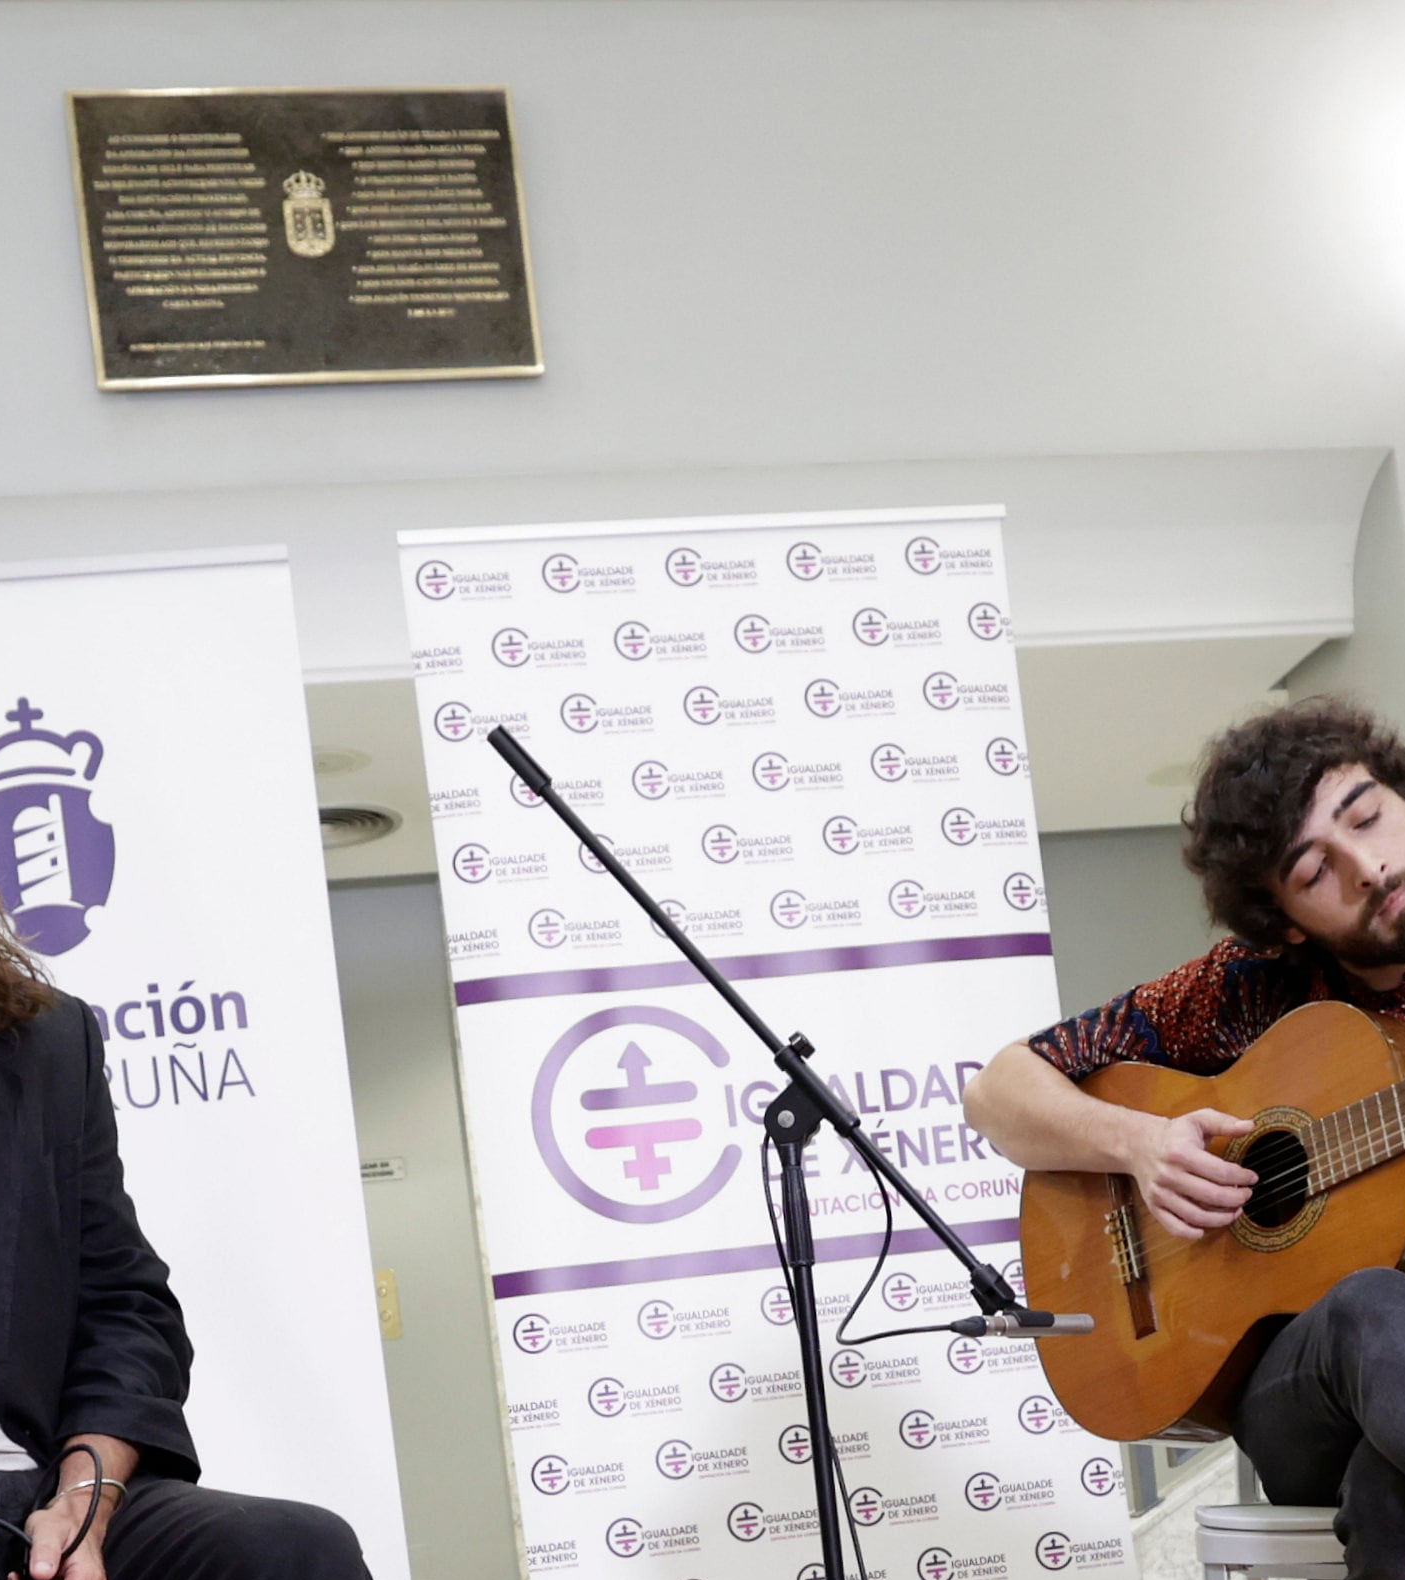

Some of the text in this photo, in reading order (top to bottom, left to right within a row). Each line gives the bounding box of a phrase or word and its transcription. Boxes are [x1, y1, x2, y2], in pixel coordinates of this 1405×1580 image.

[820, 553, 874, 564] IGUALDADE
[938, 548, 991, 558] IGUALDADE
[700, 559, 755, 570] IGUALDADE
[452, 572, 509, 582] IGUALDADE
[577, 566, 633, 576] IGUALDADE
[768, 625, 823, 636] IGUALDADE
[885, 619, 939, 630] IGUALDADE
[527, 638, 584, 649] IGUALDADE
[649, 632, 704, 643] IGUALDADE
[956, 683, 1009, 693] IGUALDADE
[838, 689, 892, 700] IGUALDADE
[718, 697, 773, 708] IGUALDADE
[595, 705, 651, 716] IGUALDADE
[904, 754, 957, 765] IGUALDADE
[786, 762, 841, 773] IGUALDADE
[667, 770, 722, 782] IGUALDADE
[973, 818, 1027, 829] IGUALDADE
[856, 825, 911, 837] IGUALDADE
[736, 835, 791, 846] IGUALDADE
[488, 853, 545, 865] IGUALDADE
[922, 890, 976, 901] IGUALDADE
[804, 899, 859, 911] IGUALDADE
[685, 909, 741, 921] IGUALDADE
[563, 919, 620, 931] IGUALDADE
[836, 1118, 1004, 1176] XÉNER
[771, 1185, 901, 1220] DUTACIÓN
[944, 1172, 1021, 1202] CORUÑ
[673, 1307, 729, 1321] IGUALDADE
[548, 1321, 606, 1335] IGUALDADE
[863, 1356, 919, 1370] IGUALDADE
[744, 1370, 800, 1384] IGUALDADE
[623, 1384, 680, 1399] IGUALDADE
[933, 1417, 988, 1431] IGUALDADE
[691, 1446, 747, 1461] IGUALDADE
[566, 1462, 624, 1476] IGUALDADE
[998, 1479, 1052, 1493] IGUALDADE
[881, 1493, 936, 1508] IGUALDADE
[641, 1524, 698, 1539] IGUALDADE
[1069, 1538, 1122, 1552] IGUALDADE
[951, 1553, 1005, 1568] IGUALDADE
